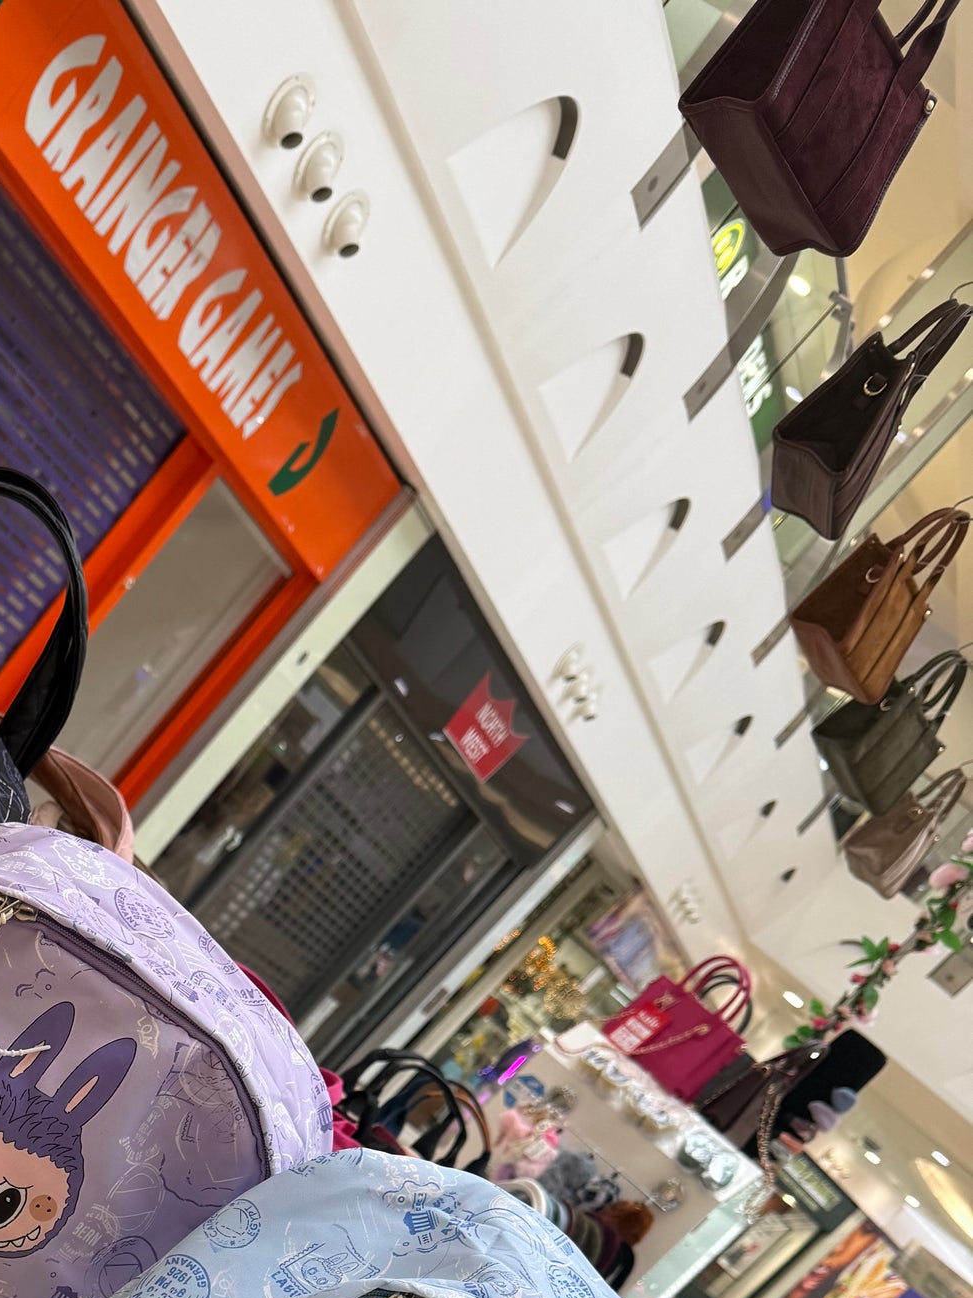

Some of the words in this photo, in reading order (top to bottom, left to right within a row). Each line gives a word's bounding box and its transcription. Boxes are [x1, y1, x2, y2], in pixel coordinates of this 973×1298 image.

[24, 33, 222, 321] GRAINGER
[177, 268, 302, 441] GAMES
[459, 725, 491, 765] WEST
[474, 699, 509, 749] NORTH
[164, 1257, 208, 1289] GERMANY
